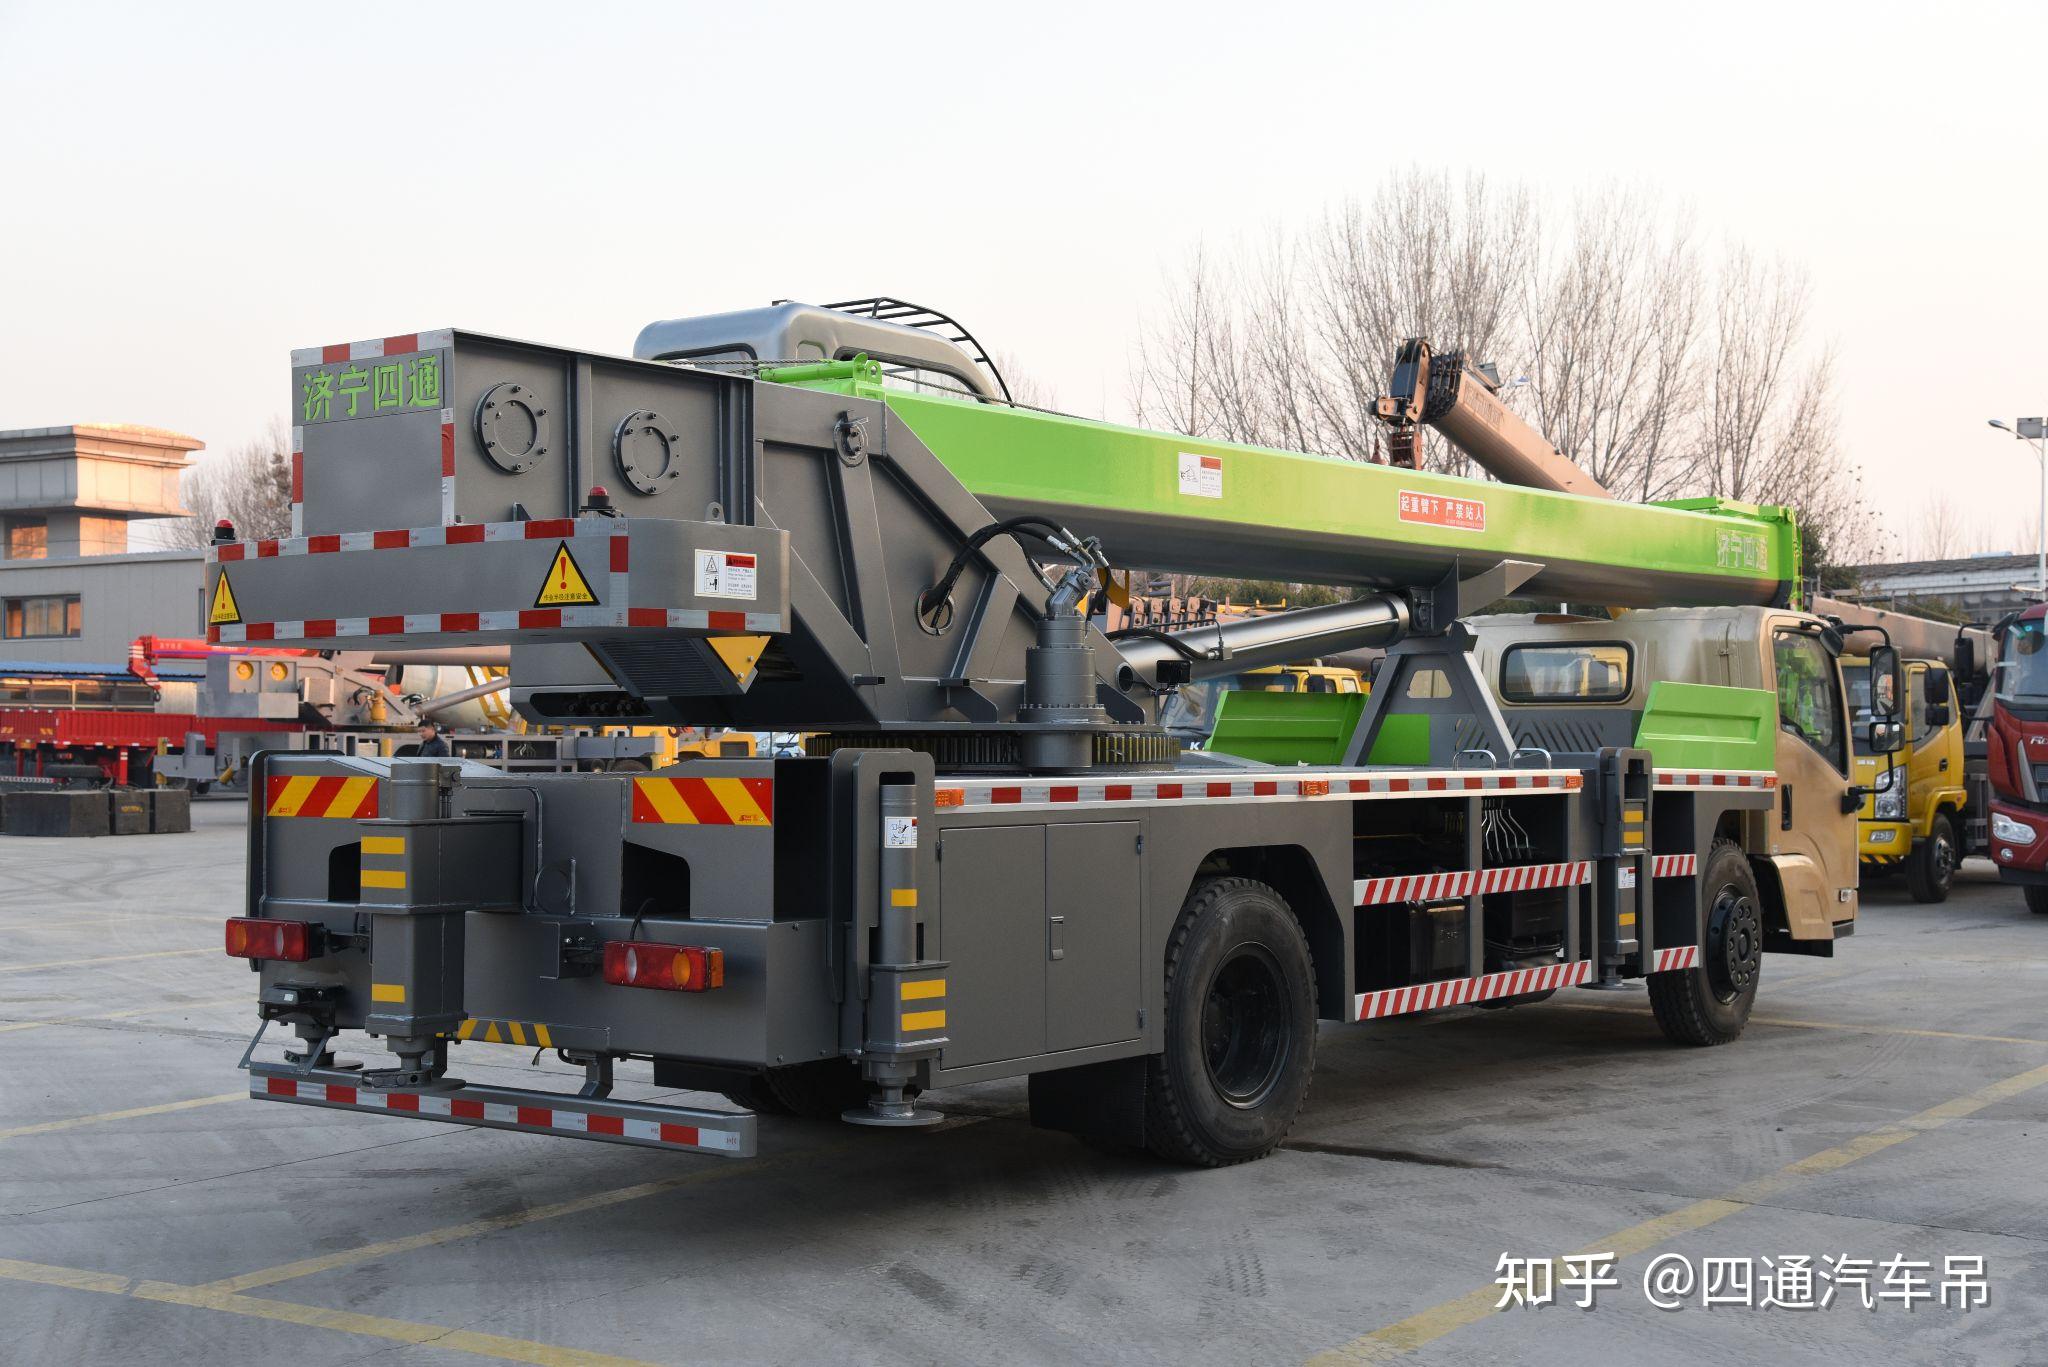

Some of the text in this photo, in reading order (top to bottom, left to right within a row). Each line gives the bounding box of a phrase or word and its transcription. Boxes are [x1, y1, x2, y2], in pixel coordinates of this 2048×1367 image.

[303, 355, 440, 421] 济宁四通
[1400, 495, 1483, 521] 起重臂下 严禁站人
